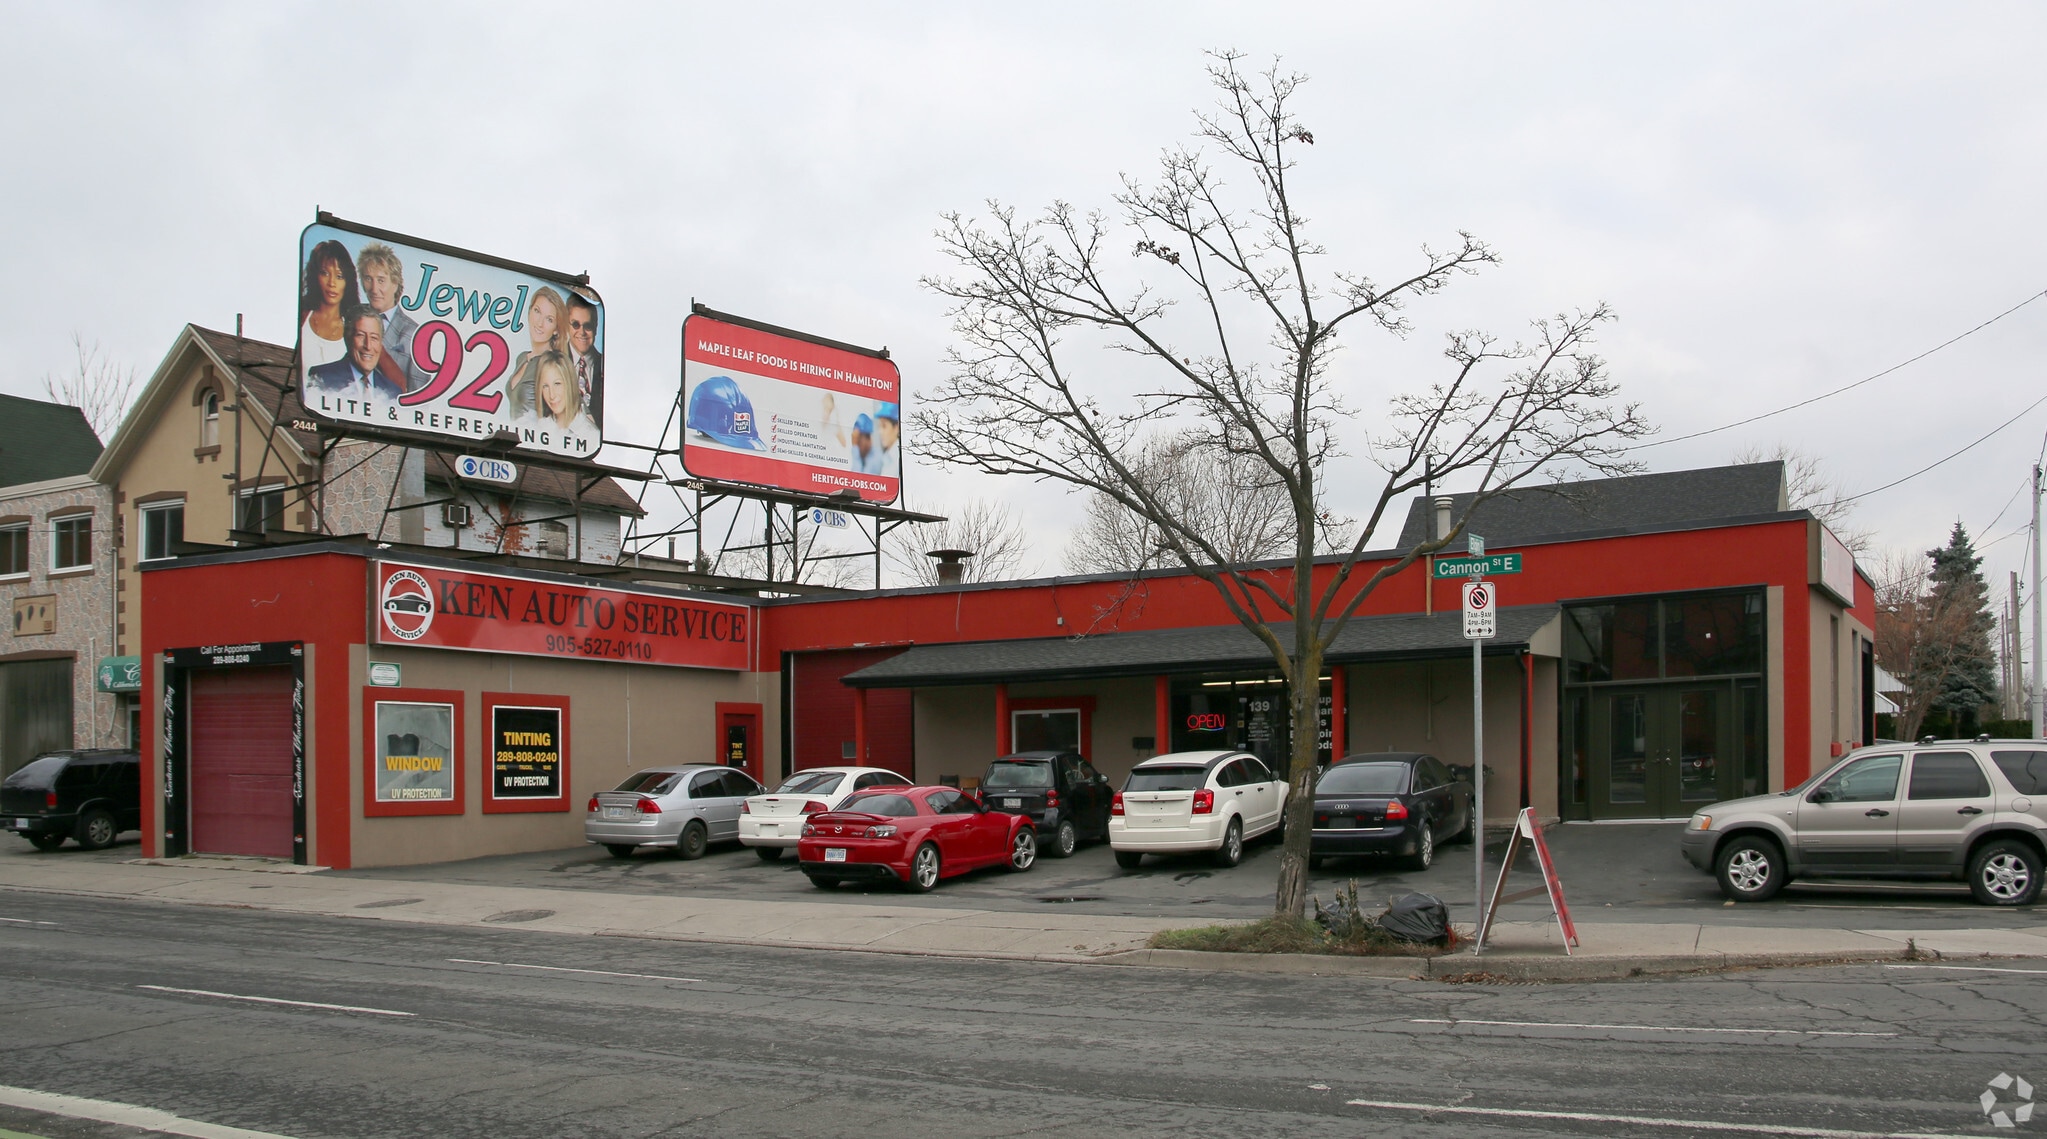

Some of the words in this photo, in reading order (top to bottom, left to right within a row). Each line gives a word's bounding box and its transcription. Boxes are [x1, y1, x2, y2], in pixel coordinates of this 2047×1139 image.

[400, 263, 529, 332] Jewel
[398, 319, 510, 414] 92
[698, 339, 730, 357] MAPLE
[732, 347, 754, 362] LEAF
[756, 352, 788, 369] FOODS
[790, 360, 798, 371] IS
[799, 362, 832, 379] HIRING
[834, 369, 843, 381] IN
[845, 373, 892, 391] HAMILTON!
[292, 419, 317, 432] 2444
[321, 395, 372, 417] LITE
[388, 407, 399, 421] &
[563, 436, 587, 453] FM
[794, 431, 818, 439] OPERATORS
[778, 438, 801, 447] INDUSTRIAL
[802, 442, 826, 450] SANITATION
[478, 459, 510, 480] CBS
[686, 481, 704, 491] 2445
[811, 472, 887, 492] HERITAGE-JOBS.COM
[824, 509, 846, 527] CBS
[1439, 562, 1489, 575] Cannon
[1492, 558, 1501, 566] St
[1504, 557, 1513, 571] E
[388, 571, 405, 585] KEN
[406, 571, 426, 588] AUTO
[437, 577, 514, 621] KEN
[520, 590, 616, 631] AUTO
[623, 602, 746, 643] SERVICE
[391, 625, 424, 639] SERVICE
[200, 646, 212, 655] Call
[213, 645, 223, 654] For
[224, 643, 261, 655] Appointment
[545, 634, 652, 660] 905-527-0110
[1248, 700, 1270, 712] 139
[1186, 713, 1226, 729] OPEN
[503, 731, 551, 746] TINTING
[385, 756, 443, 772] WINDOW
[496, 751, 557, 762] 289-808-0240
[503, 776, 513, 787] UV
[513, 775, 549, 787] PROTECTION
[391, 788, 401, 799] UV
[402, 788, 442, 799] PROTECTION
